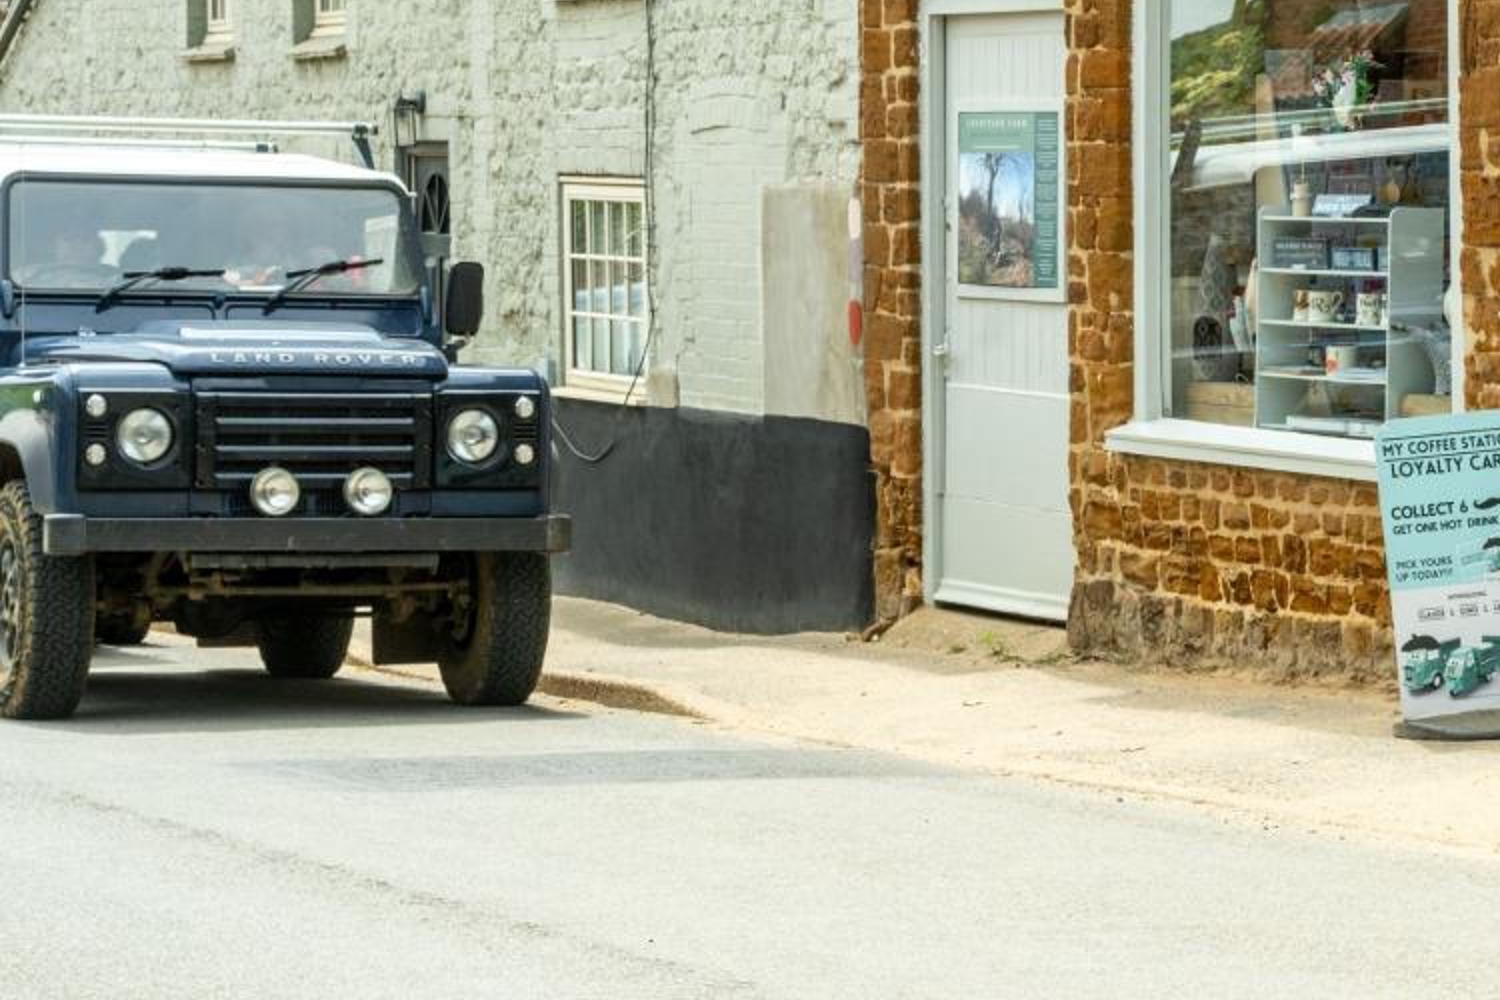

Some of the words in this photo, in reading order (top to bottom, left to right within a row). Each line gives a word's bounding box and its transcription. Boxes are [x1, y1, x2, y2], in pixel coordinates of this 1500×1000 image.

[211, 352, 295, 363] LAND
[314, 354, 416, 365] ROVER
[1382, 442, 1403, 456] MY
[1408, 438, 1457, 454] COFFEE
[1391, 457, 1463, 478] LOYALTY
[1391, 501, 1454, 520] COLLECT
[1460, 500, 1468, 513] 6
[1393, 524, 1412, 535] GET
[1415, 522, 1438, 533] ONE
[1440, 519, 1462, 531] HOT
[1467, 515, 1498, 528] DRINK
